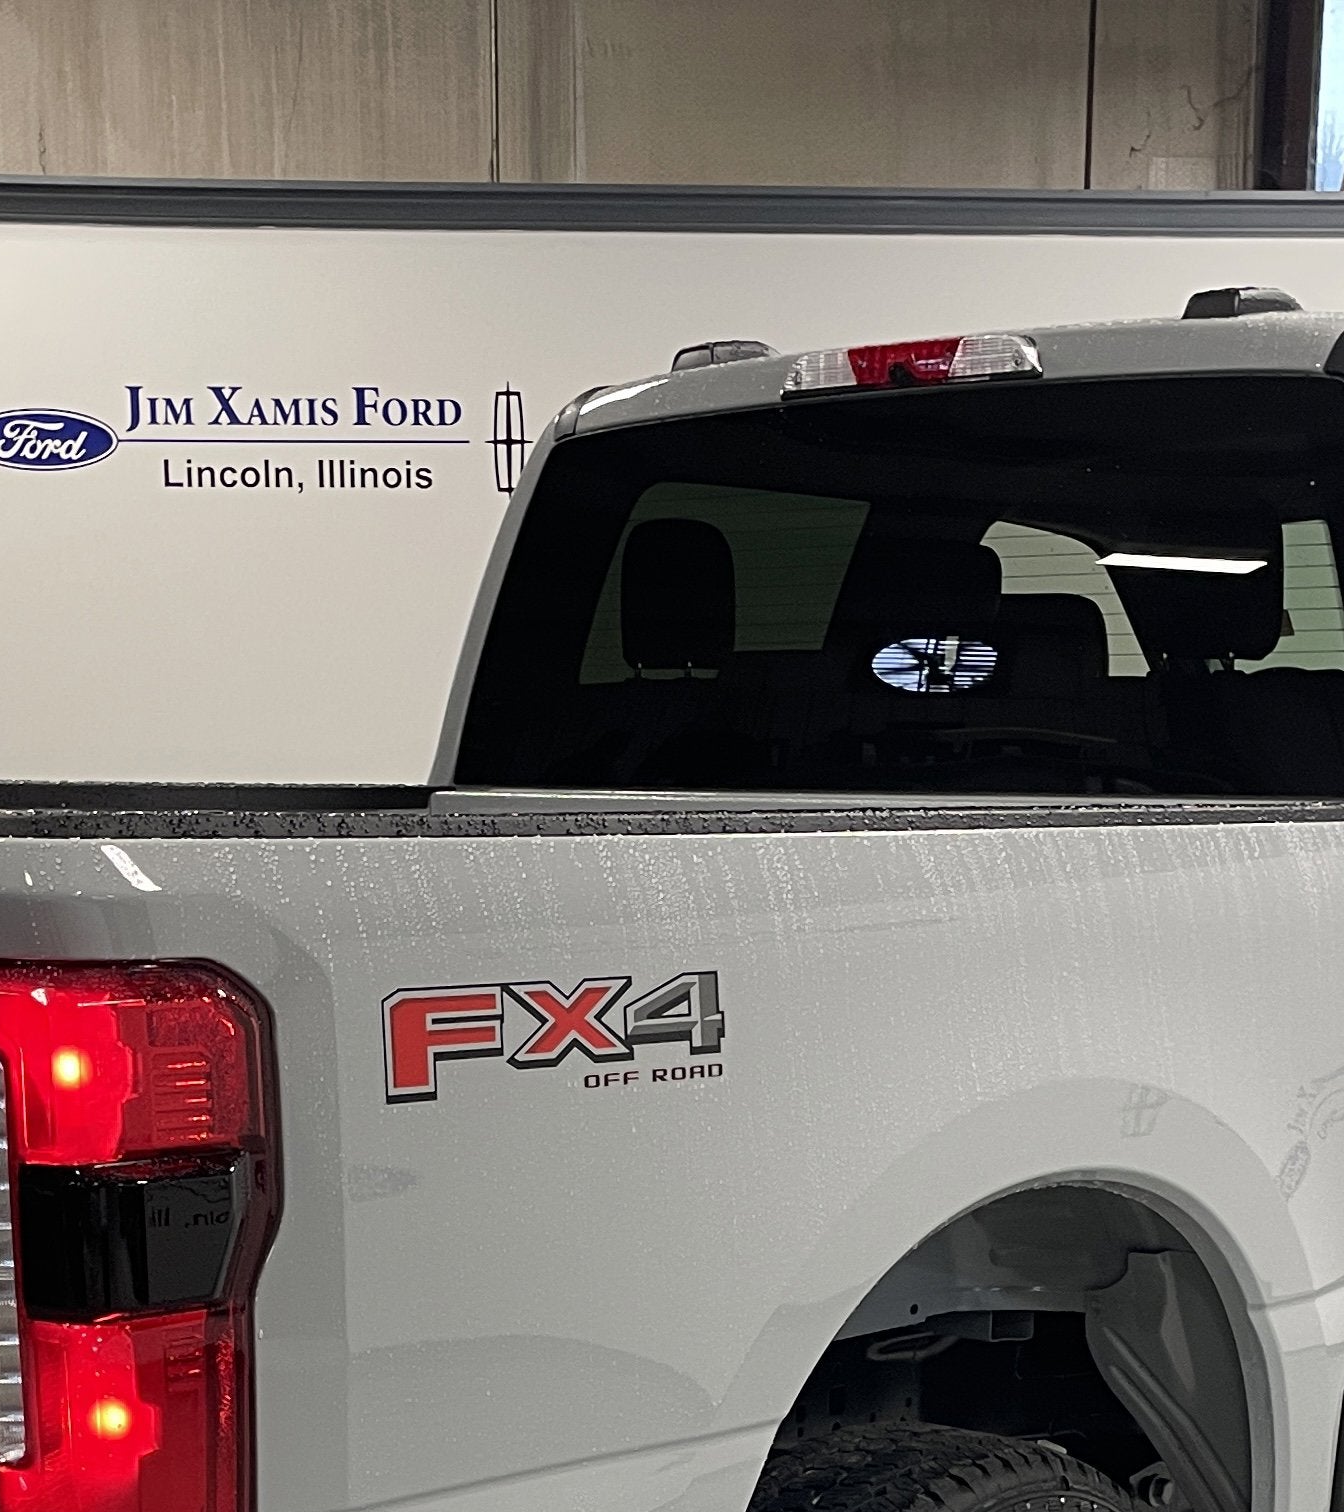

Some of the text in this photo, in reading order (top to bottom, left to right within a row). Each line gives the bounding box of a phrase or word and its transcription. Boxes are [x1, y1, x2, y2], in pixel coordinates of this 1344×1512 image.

[124, 385, 462, 433] JIM XAMIS FORD
[163, 459, 433, 493] Lincoln, Illinois
[382, 971, 725, 1105] FX4
[584, 1063, 724, 1089] OFF ROAD
